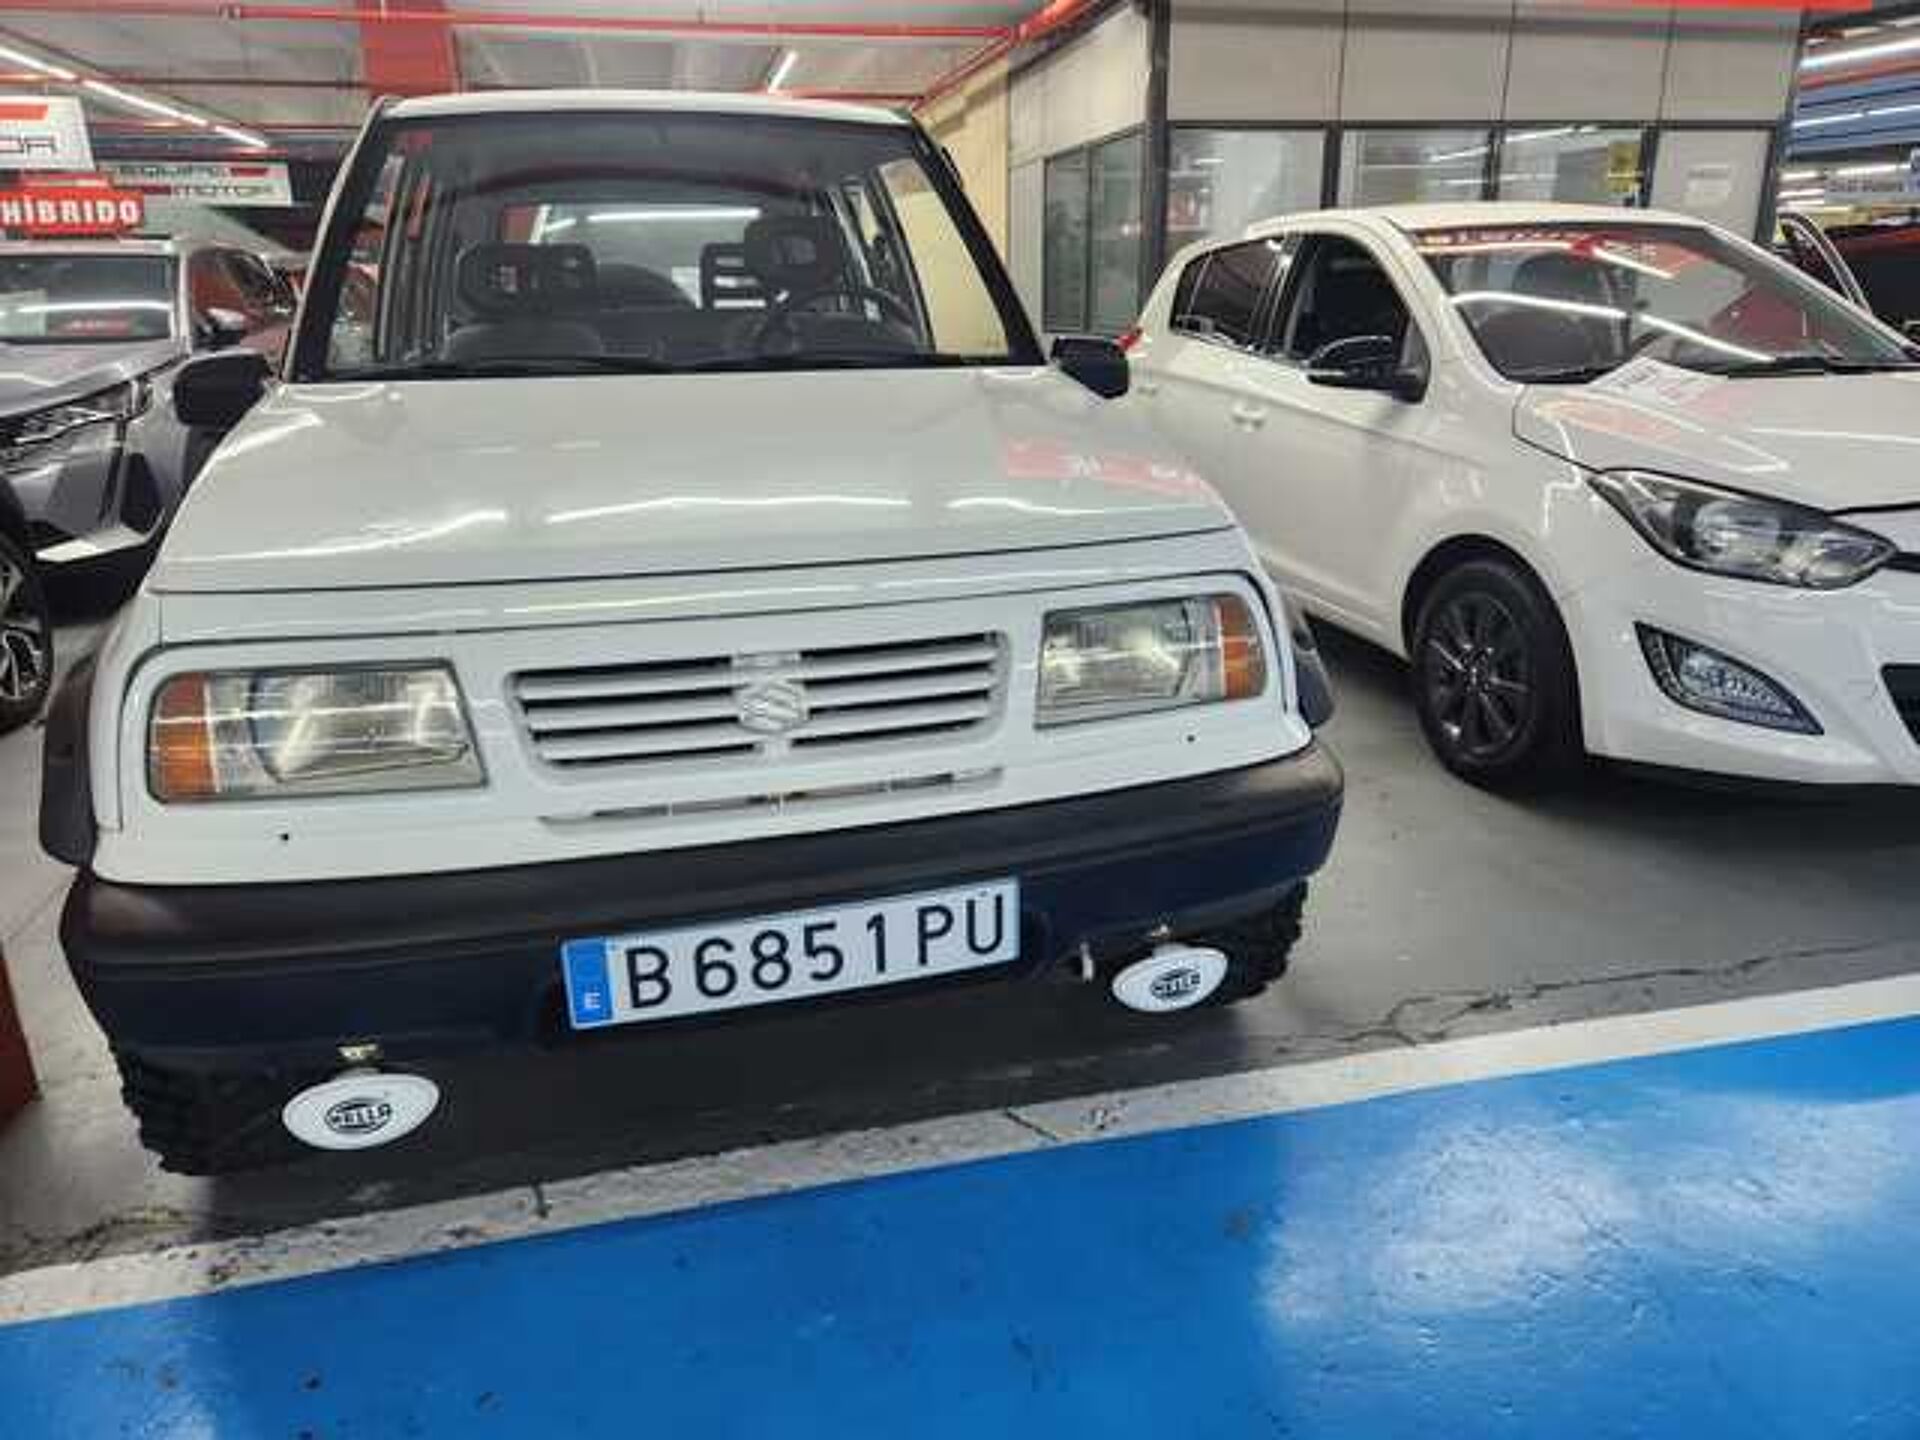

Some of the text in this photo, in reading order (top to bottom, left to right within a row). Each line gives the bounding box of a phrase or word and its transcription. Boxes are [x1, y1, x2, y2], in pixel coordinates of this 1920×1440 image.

[624, 893, 1004, 1010] B 6851 PU
